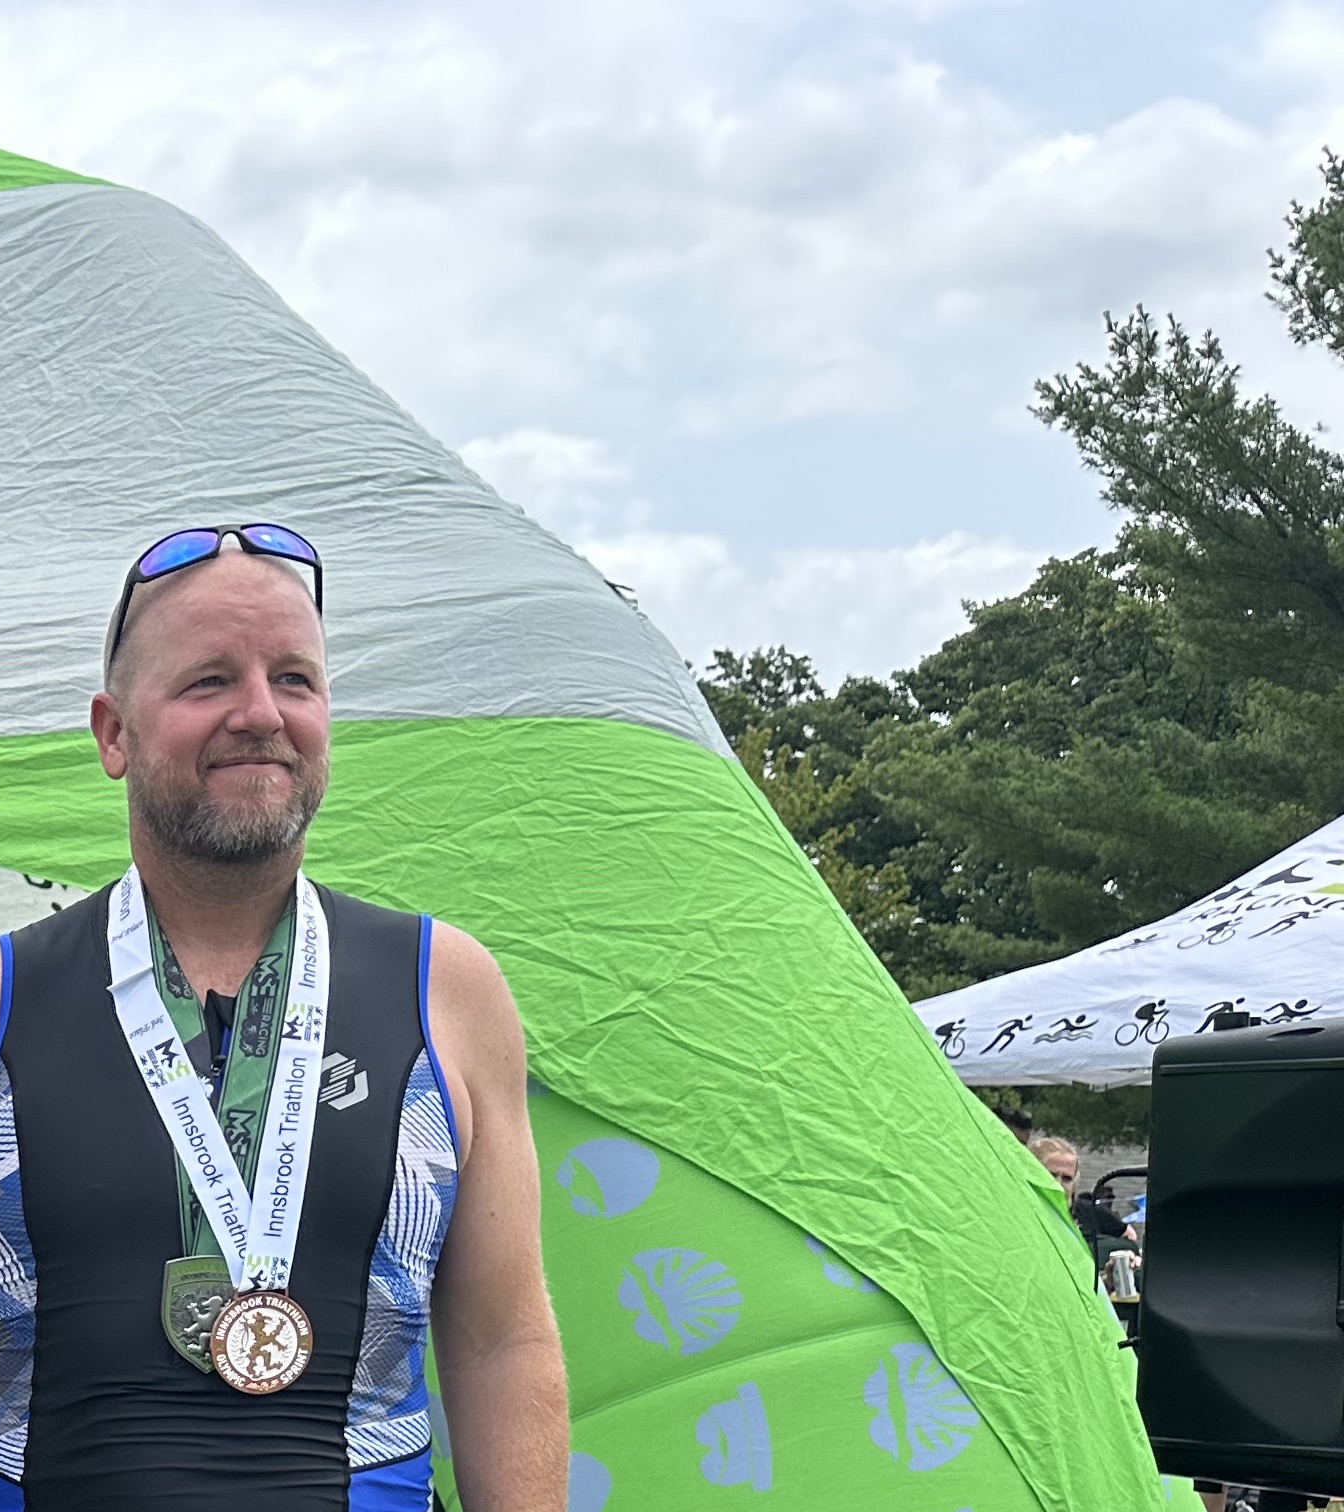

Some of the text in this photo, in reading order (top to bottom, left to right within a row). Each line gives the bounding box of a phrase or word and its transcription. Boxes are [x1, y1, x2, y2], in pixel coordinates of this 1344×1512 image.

[298, 913, 318, 989] Innsbrook
[255, 1014, 272, 1056] RACING
[172, 1096, 223, 1188] Innsbrook
[263, 1057, 307, 1238] Innsbrook Triathlon
[215, 1295, 309, 1341] INNSBROOK TRIATHLON
[216, 1349, 309, 1387] OLYMPIC SPRINT
